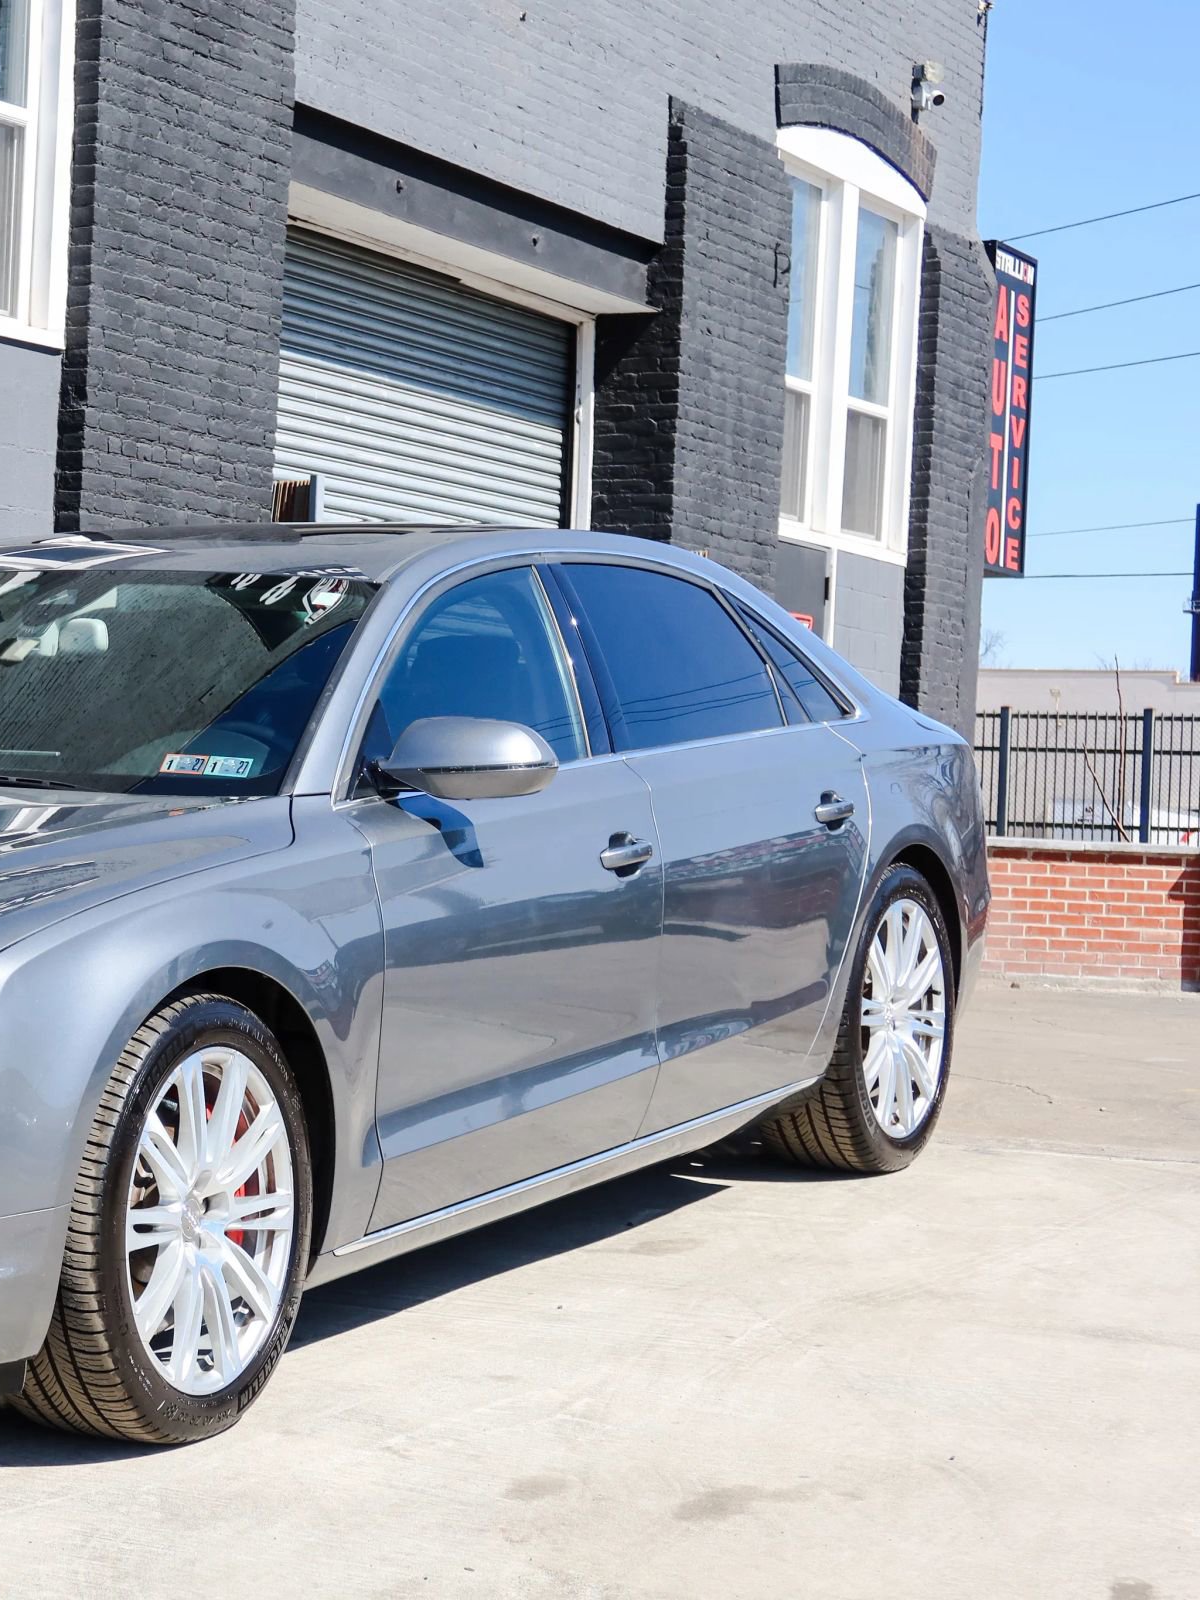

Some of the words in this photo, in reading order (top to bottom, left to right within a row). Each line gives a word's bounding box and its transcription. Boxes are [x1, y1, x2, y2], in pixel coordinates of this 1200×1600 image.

[995, 249, 1035, 286] STALLION
[985, 284, 1008, 566] AUTO
[1005, 294, 1030, 571] SERVICE
[166, 760, 174, 770] 1
[191, 758, 205, 772] 27
[210, 762, 218, 773] 1
[236, 761, 250, 774] 27
[239, 1321, 289, 1410] MICHELIN
